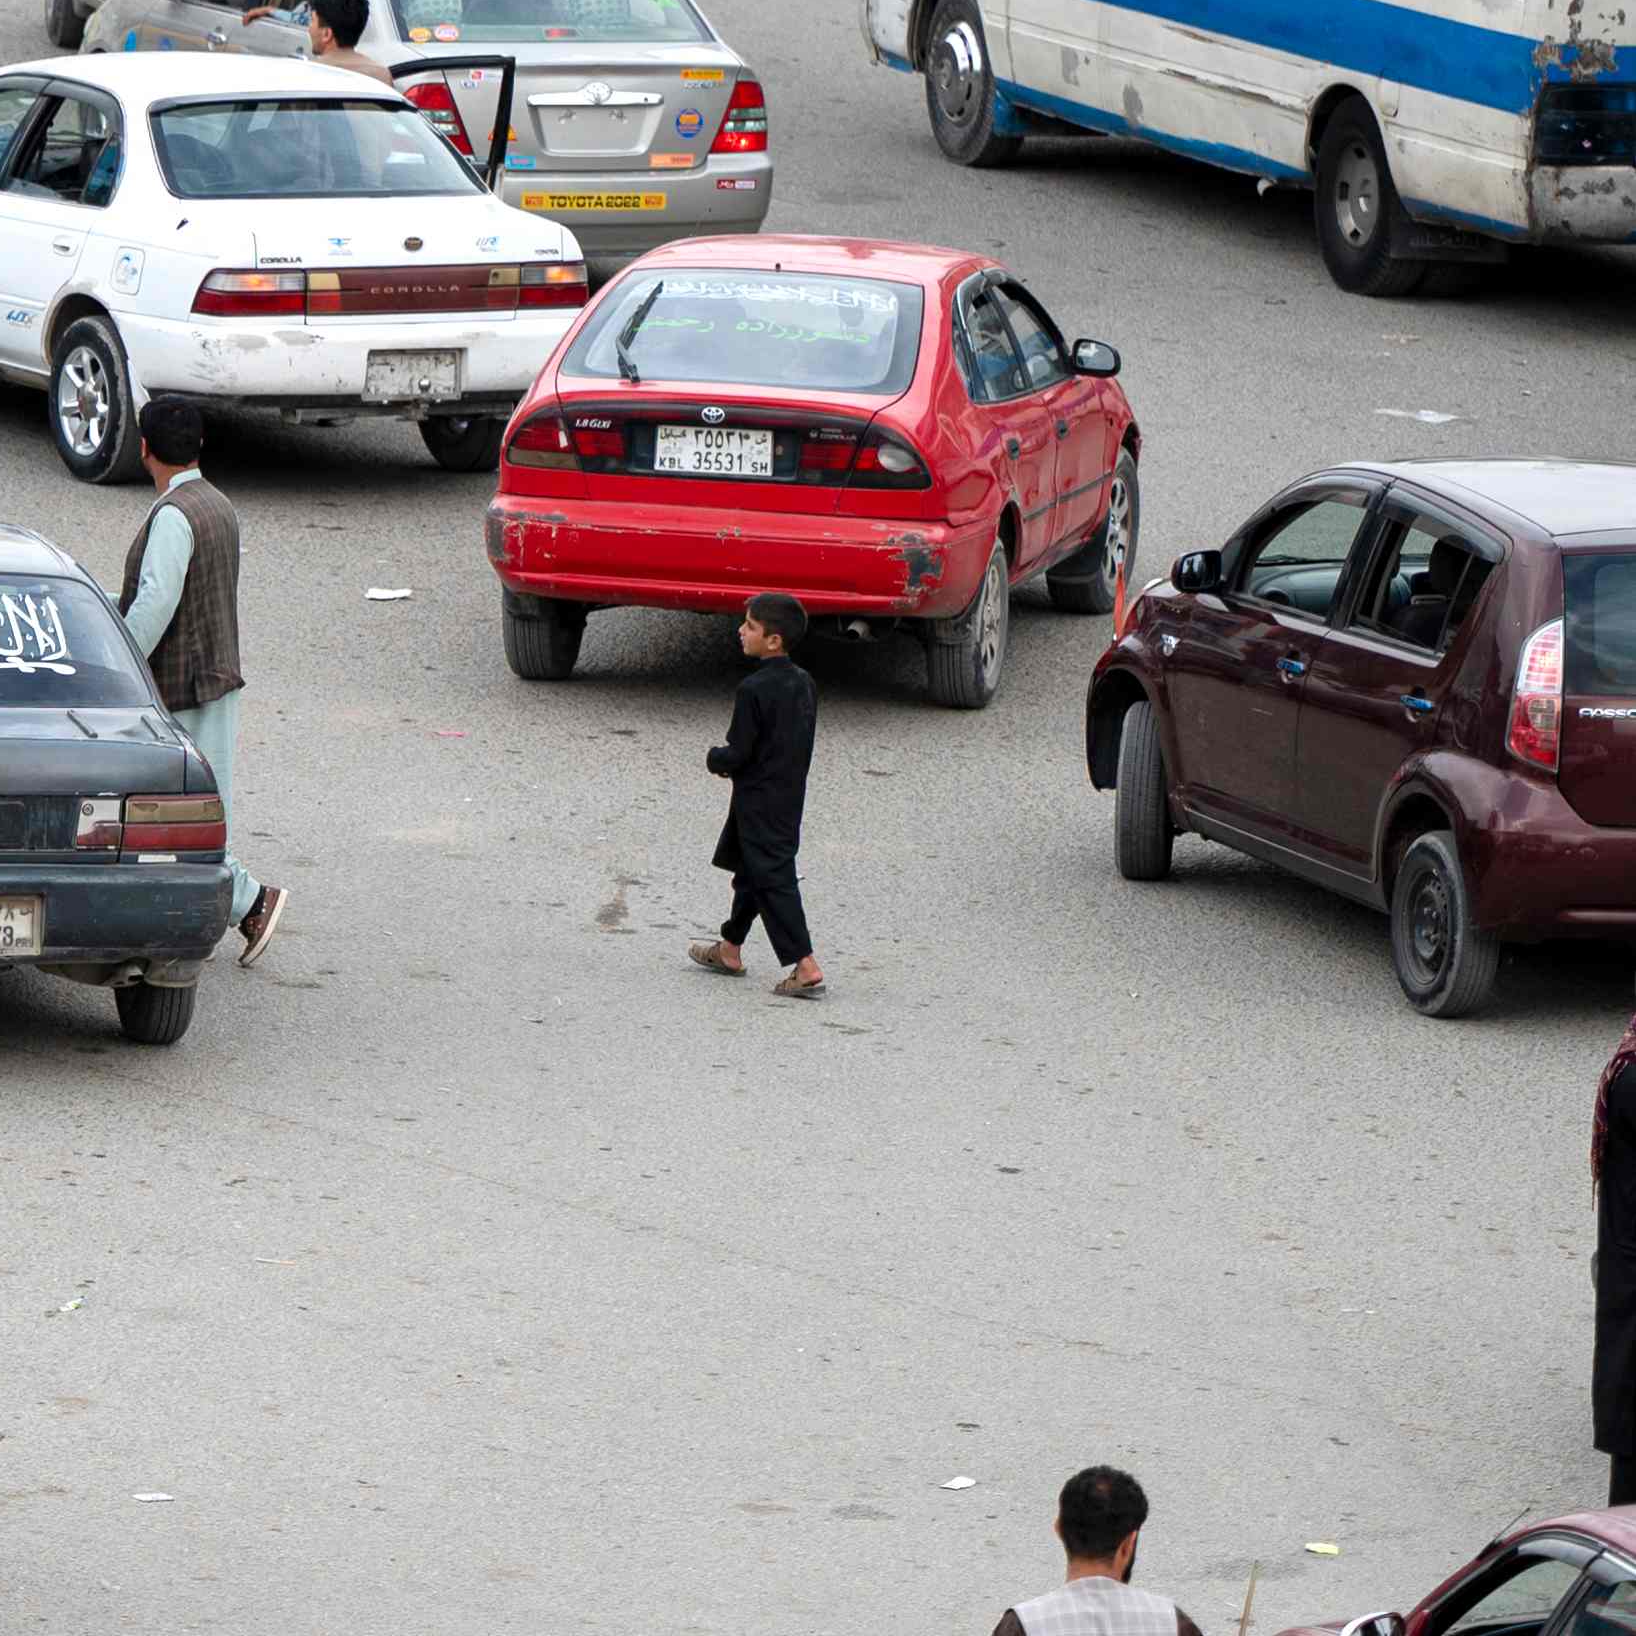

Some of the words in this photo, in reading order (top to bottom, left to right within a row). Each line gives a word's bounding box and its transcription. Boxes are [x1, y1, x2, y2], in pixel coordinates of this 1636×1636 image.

[548, 195, 605, 209] TOYOTA
[369, 283, 462, 295] COROLLA
[693, 451, 743, 472] 35531
